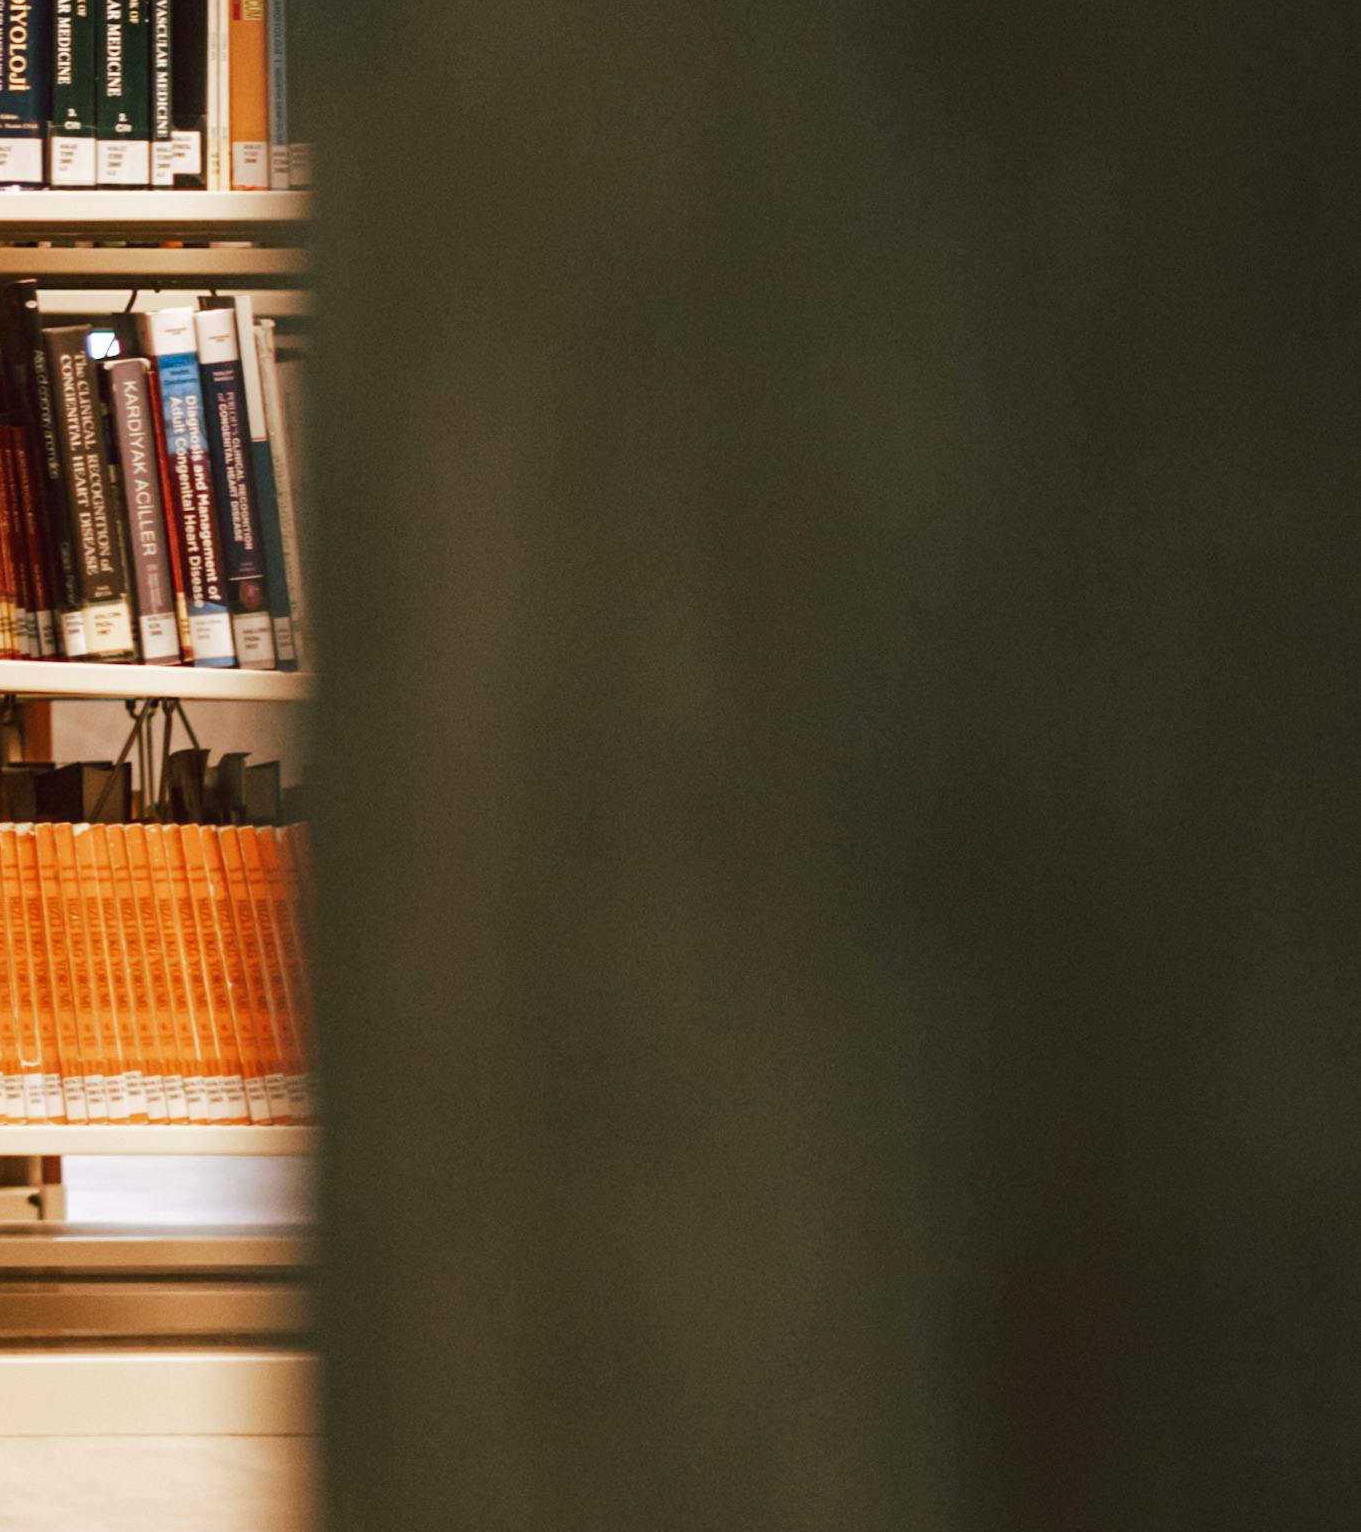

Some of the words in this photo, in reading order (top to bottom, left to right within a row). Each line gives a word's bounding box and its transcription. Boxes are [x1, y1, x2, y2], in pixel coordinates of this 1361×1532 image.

[57, 18, 72, 85] MEDICINE
[106, 24, 122, 97] MEDICINE
[74, 351, 87, 377] The
[76, 380, 97, 449] CLINICAL
[123, 379, 149, 475] KARDİYAK
[87, 453, 112, 556] RECOGNITION
[134, 478, 158, 556] ACİLLER
[101, 556, 115, 572] of
